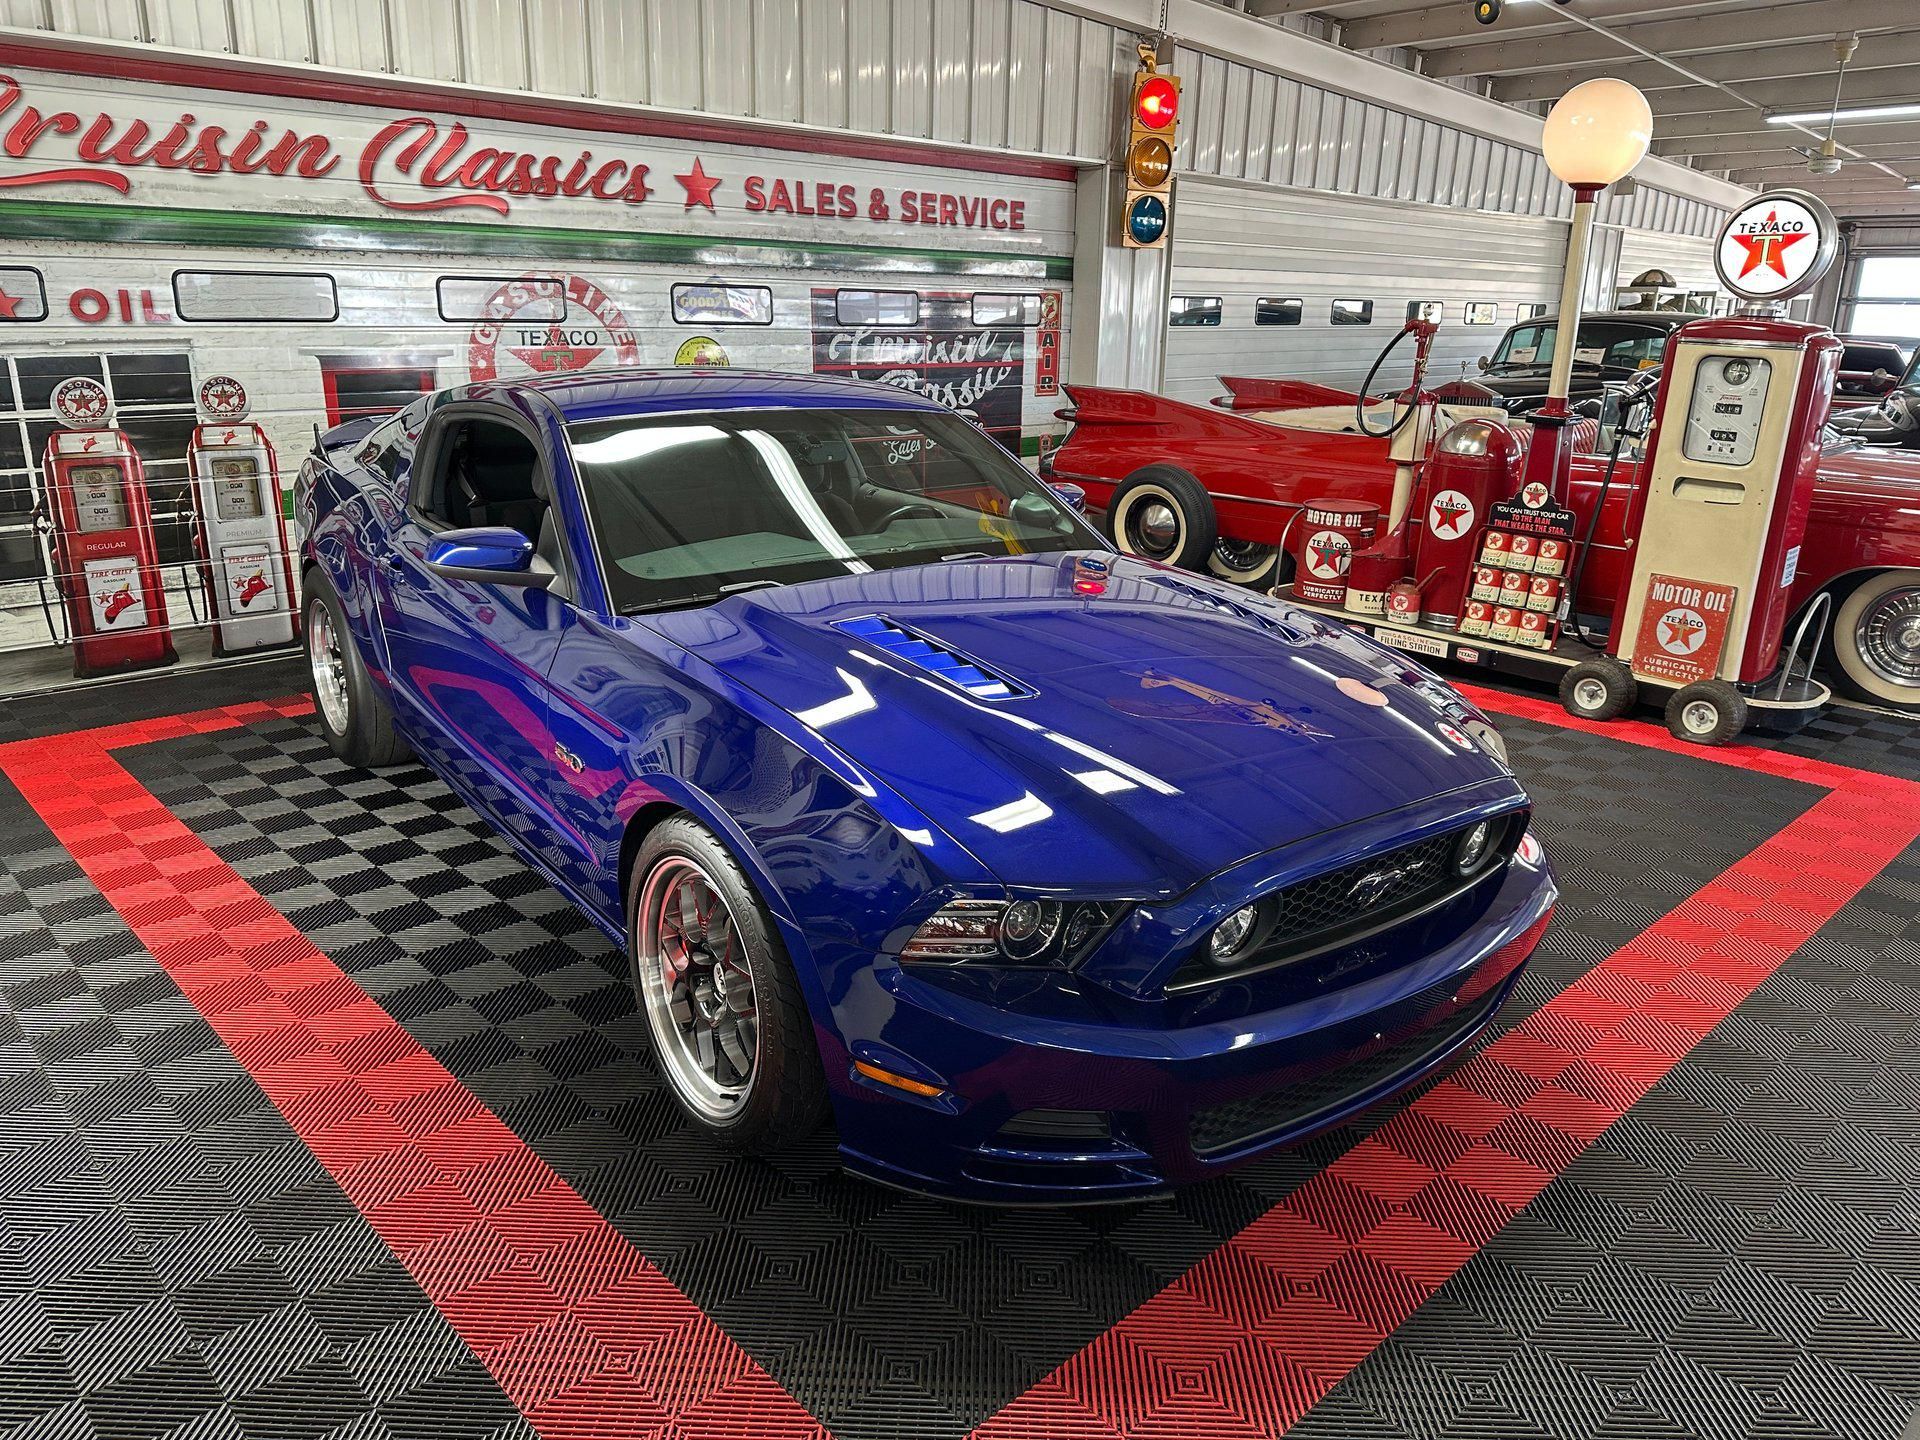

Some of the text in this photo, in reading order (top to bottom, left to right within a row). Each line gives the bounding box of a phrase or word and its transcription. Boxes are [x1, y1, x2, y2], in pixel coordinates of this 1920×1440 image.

[358, 116, 654, 216] Classics
[744, 175, 1026, 230] SALES & SERVICE
[1740, 221, 1804, 234] TEXACO
[69, 288, 171, 323] OIL
[474, 275, 639, 345] GASOLINE
[516, 329, 598, 347] TEXACO
[1040, 332, 1056, 390] AIR
[58, 381, 104, 400] GASOLINE
[202, 378, 244, 395] GASOLINE
[883, 439, 921, 465] Sales
[1436, 499, 1467, 510] TEXACO
[1306, 509, 1362, 528] MOTOR OIL
[1521, 515, 1532, 523] THE
[1534, 517, 1551, 525] MAN
[1524, 509, 1540, 517] TRUST
[1540, 511, 1556, 519] YOUR
[226, 529, 262, 538] PREMIUM
[1494, 519, 1509, 527] THAT
[1510, 522, 1534, 531] WEARS
[1535, 525, 1547, 533] THE
[86, 541, 127, 551] REGULAR
[1312, 538, 1349, 550] TEXACO
[1303, 585, 1344, 595] LUBRICATES
[1303, 591, 1341, 601] PERFECTLY
[1652, 582, 1727, 612] MOTOR OIL
[1359, 593, 1391, 603] TEXAC
[1665, 615, 1704, 628] TEXACO
[1380, 636, 1441, 655] FILLING STATION
[1392, 633, 1429, 645] GASOLINE
[1457, 651, 1477, 659] TEXACO
[1643, 656, 1705, 675] LUBRICATES
[1644, 664, 1700, 681] PERFECTLY
